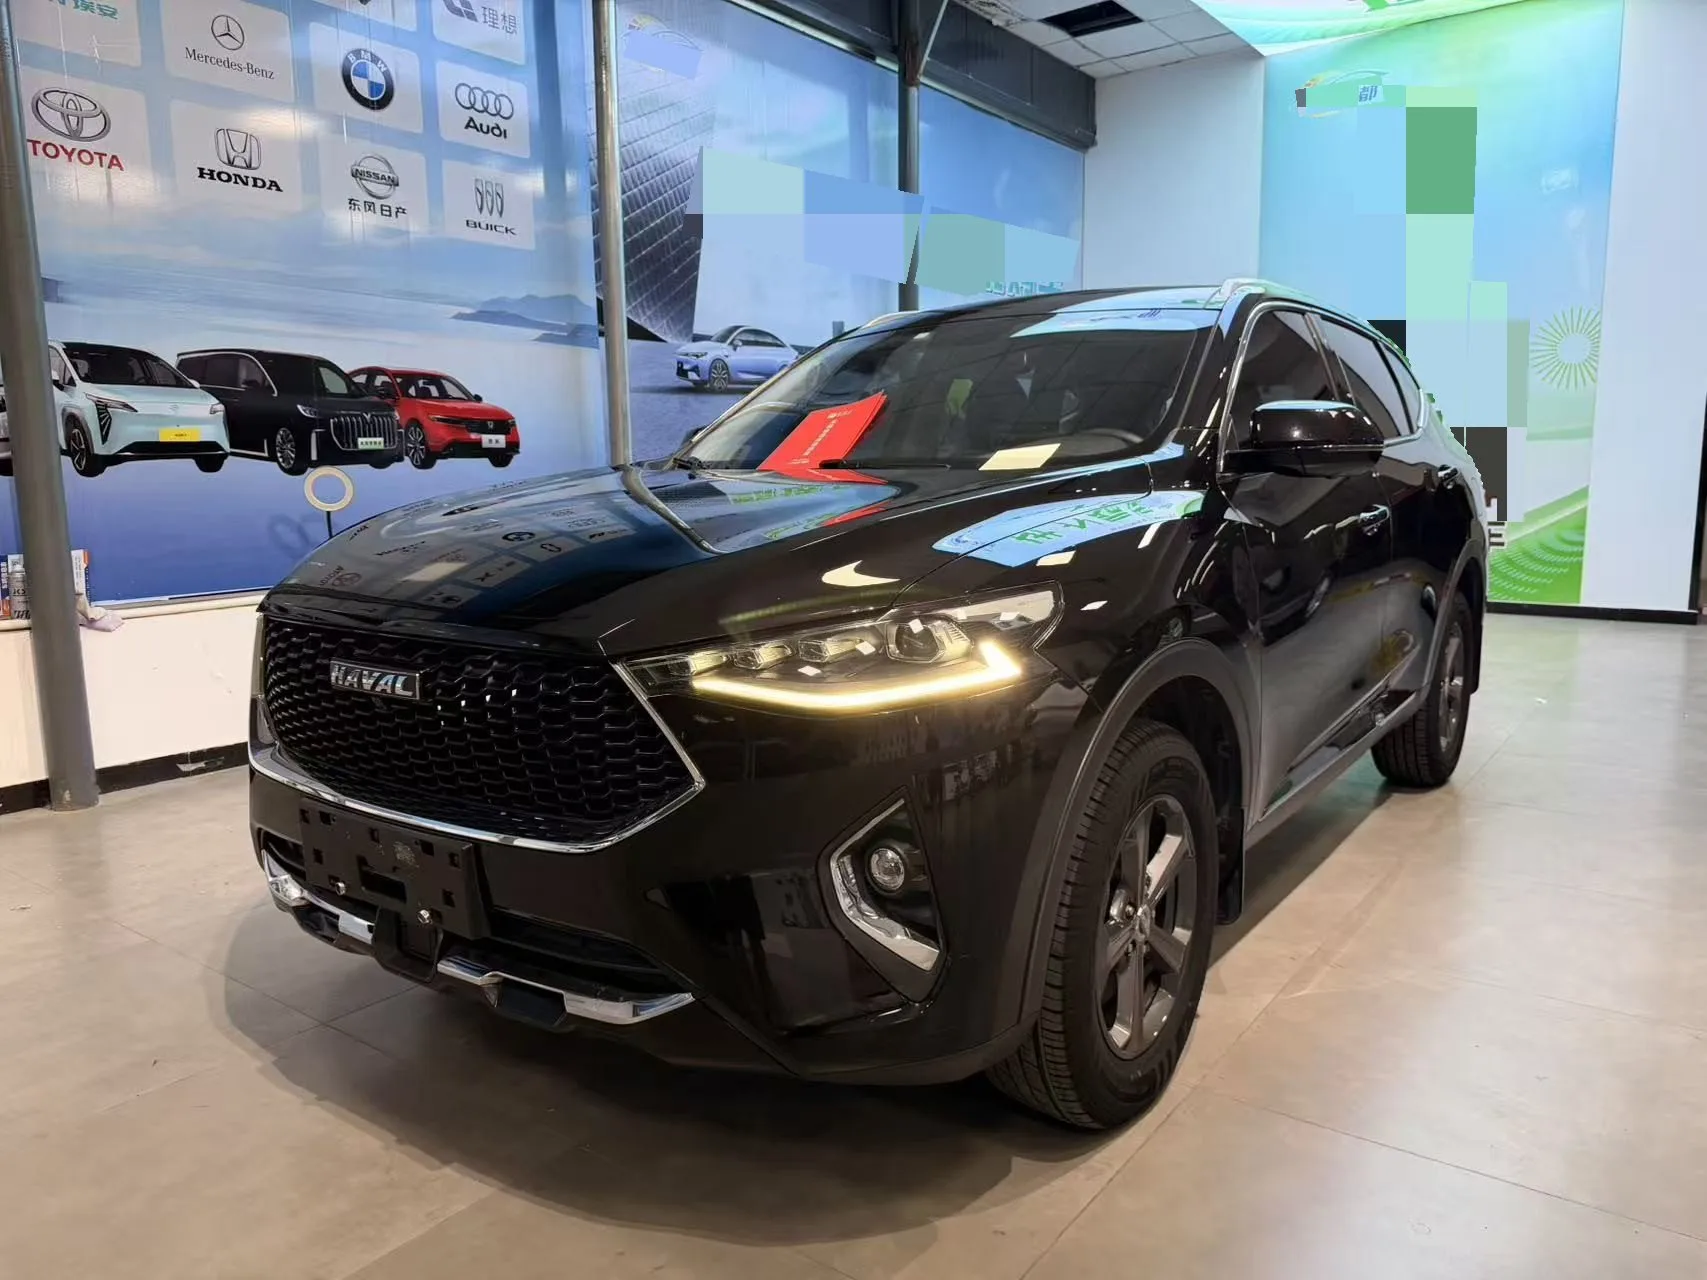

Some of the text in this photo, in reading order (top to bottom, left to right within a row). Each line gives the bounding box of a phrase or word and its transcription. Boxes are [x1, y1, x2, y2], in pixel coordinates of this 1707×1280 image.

[481, 6, 518, 35] 理想
[185, 47, 275, 80] Mercedes-Benz
[347, 50, 388, 72] BMW
[464, 116, 507, 139] Audi
[27, 138, 124, 171] TOYOTA
[197, 167, 283, 192] HONDA
[354, 168, 395, 184] NISSAN
[348, 198, 408, 218] 东风日产
[466, 219, 516, 235] BUICK
[331, 664, 413, 697] HAVAL
